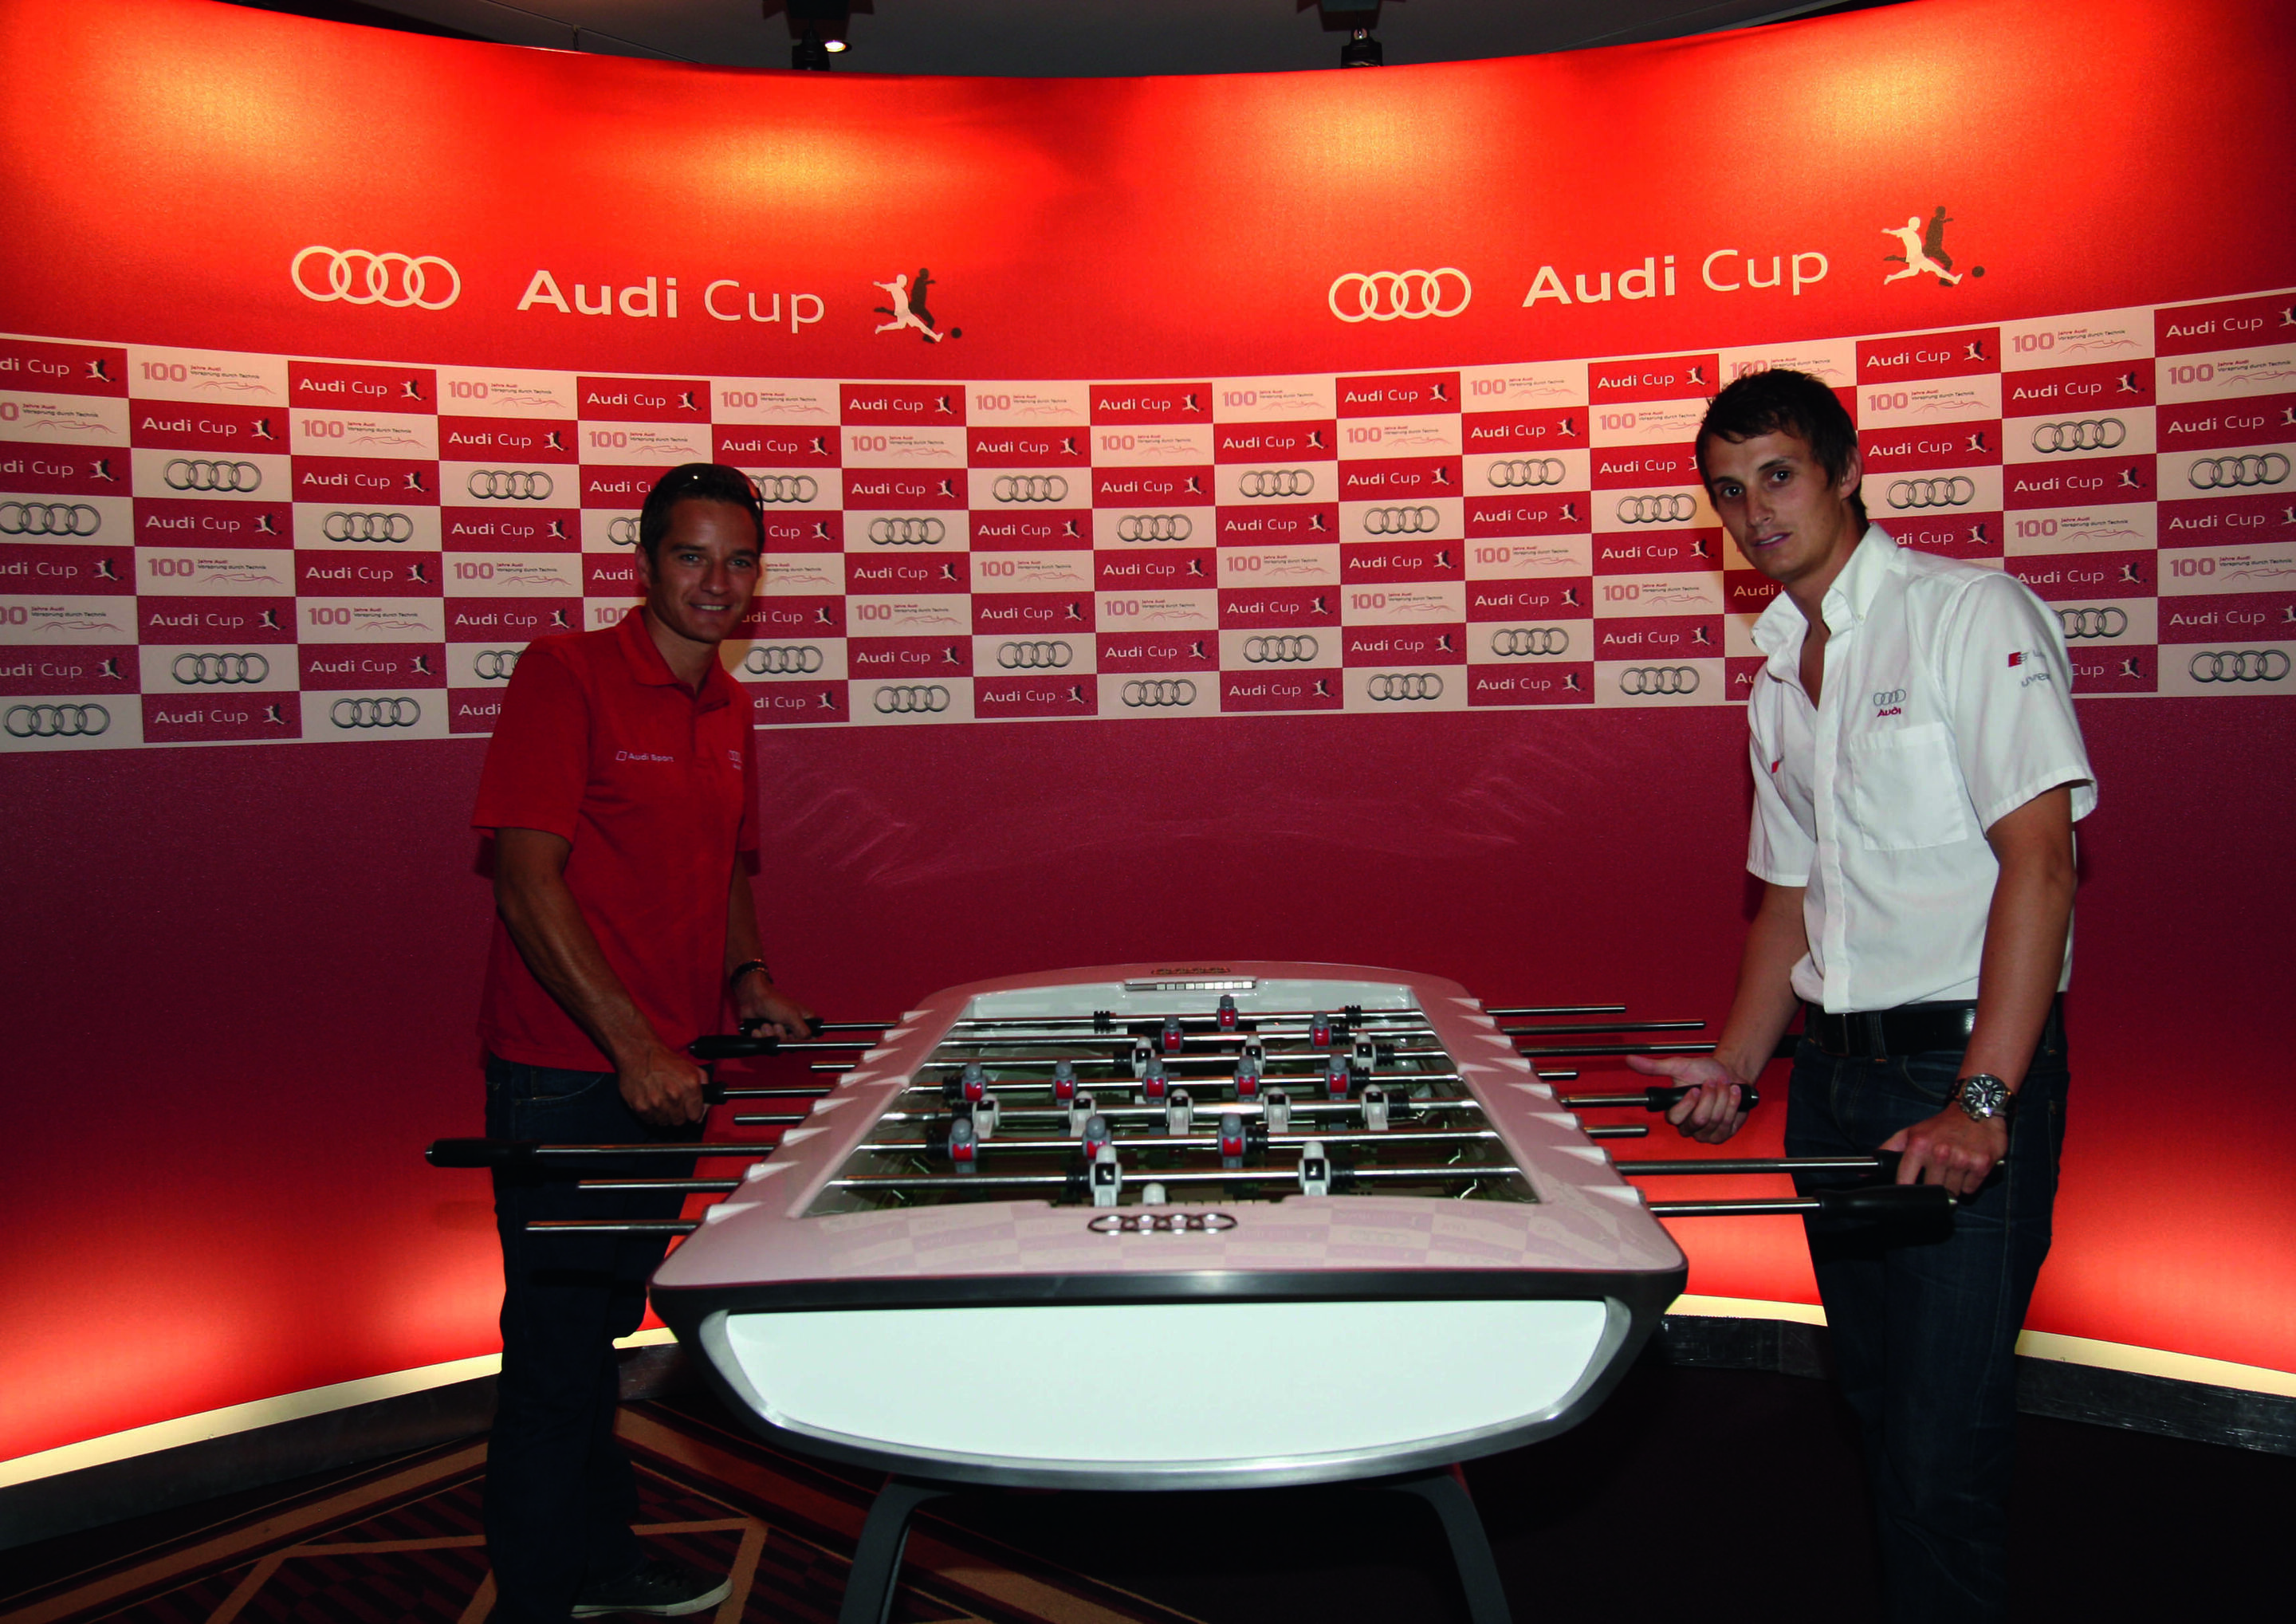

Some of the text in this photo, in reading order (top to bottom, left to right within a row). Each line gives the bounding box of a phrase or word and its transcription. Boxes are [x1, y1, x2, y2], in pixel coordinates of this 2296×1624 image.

[1522, 249, 1830, 308] Audi Cup
[517, 269, 825, 333] Audi Cup
[2166, 318, 2263, 338] Audi Cup
[2011, 332, 2054, 353] 100
[1866, 351, 1951, 368] Audi Cup
[29, 360, 72, 378] Cup
[140, 362, 187, 383] 100
[2168, 364, 2214, 385] 100
[299, 379, 387, 398] Audi Cup
[448, 380, 489, 399] 100
[1597, 374, 1673, 389] Audi Cup
[1345, 390, 1419, 403] Audi Cup
[2012, 382, 2102, 400] Audi Cup
[587, 393, 667, 409] Audi Cup
[849, 399, 925, 414] Audi Cup
[1869, 391, 1909, 411] 100
[141, 417, 238, 437] Audi Cup
[301, 419, 344, 438] 100
[1599, 413, 1637, 431] 100
[2168, 415, 2264, 434] Audi Cup
[1471, 424, 1545, 438] Audi Cup
[448, 432, 533, 449] Audi Cup
[589, 431, 629, 448] 100
[721, 438, 798, 454] Audi Cup
[851, 436, 887, 452] 100
[1222, 436, 1295, 449] Audi Cup
[976, 441, 1049, 455] Audi Cup
[1869, 441, 1953, 458] Audi Cup
[33, 461, 75, 479] Cup
[1599, 460, 1677, 474] Audi Cup
[302, 472, 391, 490] Audi Cup
[589, 480, 630, 493] Audi
[1100, 481, 1173, 494] Audi Cup
[1347, 473, 1421, 486] Audi Cup
[2013, 476, 2103, 493] Audi Cup
[851, 483, 926, 497] Audi Cup
[145, 515, 240, 533] Audi Cup
[2015, 518, 2058, 538] 100
[2168, 513, 2264, 530] Audi Cup
[451, 522, 535, 538] Audi Cup
[769, 525, 801, 540] Cup
[1920, 532, 1954, 545] Cup
[1474, 546, 1510, 564] 100
[1601, 545, 1679, 559] Audi Cup
[37, 563, 79, 580] Cup
[148, 558, 195, 577] 100
[454, 562, 494, 580] 100
[592, 568, 634, 580] Audi
[980, 560, 1016, 577] 100
[2170, 557, 2215, 577] 100
[2018, 570, 2105, 584] Audi Cup
[1602, 584, 1639, 601] 100
[1733, 584, 1774, 597] Audi
[1105, 600, 1140, 616] 100
[1226, 601, 1299, 615] Audi Cup
[1350, 593, 1386, 610] 100
[1475, 593, 1550, 607] Audi Cup
[309, 608, 352, 626] 100
[454, 613, 539, 627] Audi Cup
[772, 611, 804, 625] Cup
[855, 604, 892, 621] 100
[981, 607, 1054, 620] Audi Cup
[2169, 611, 2266, 627] Audi Cup
[149, 613, 245, 629] Audi Cup
[1350, 639, 1425, 653] Audi Cup
[1602, 631, 1681, 646] Audi Cup
[856, 651, 931, 665] Audi Cup
[1105, 646, 1177, 659] Audi Cup
[41, 663, 83, 679] Cup
[310, 659, 398, 674] Audi Cup
[1476, 678, 1551, 691] Audi Cup
[458, 703, 502, 716] Audi
[774, 696, 806, 710] Cup
[154, 710, 248, 725] Audi Cup
